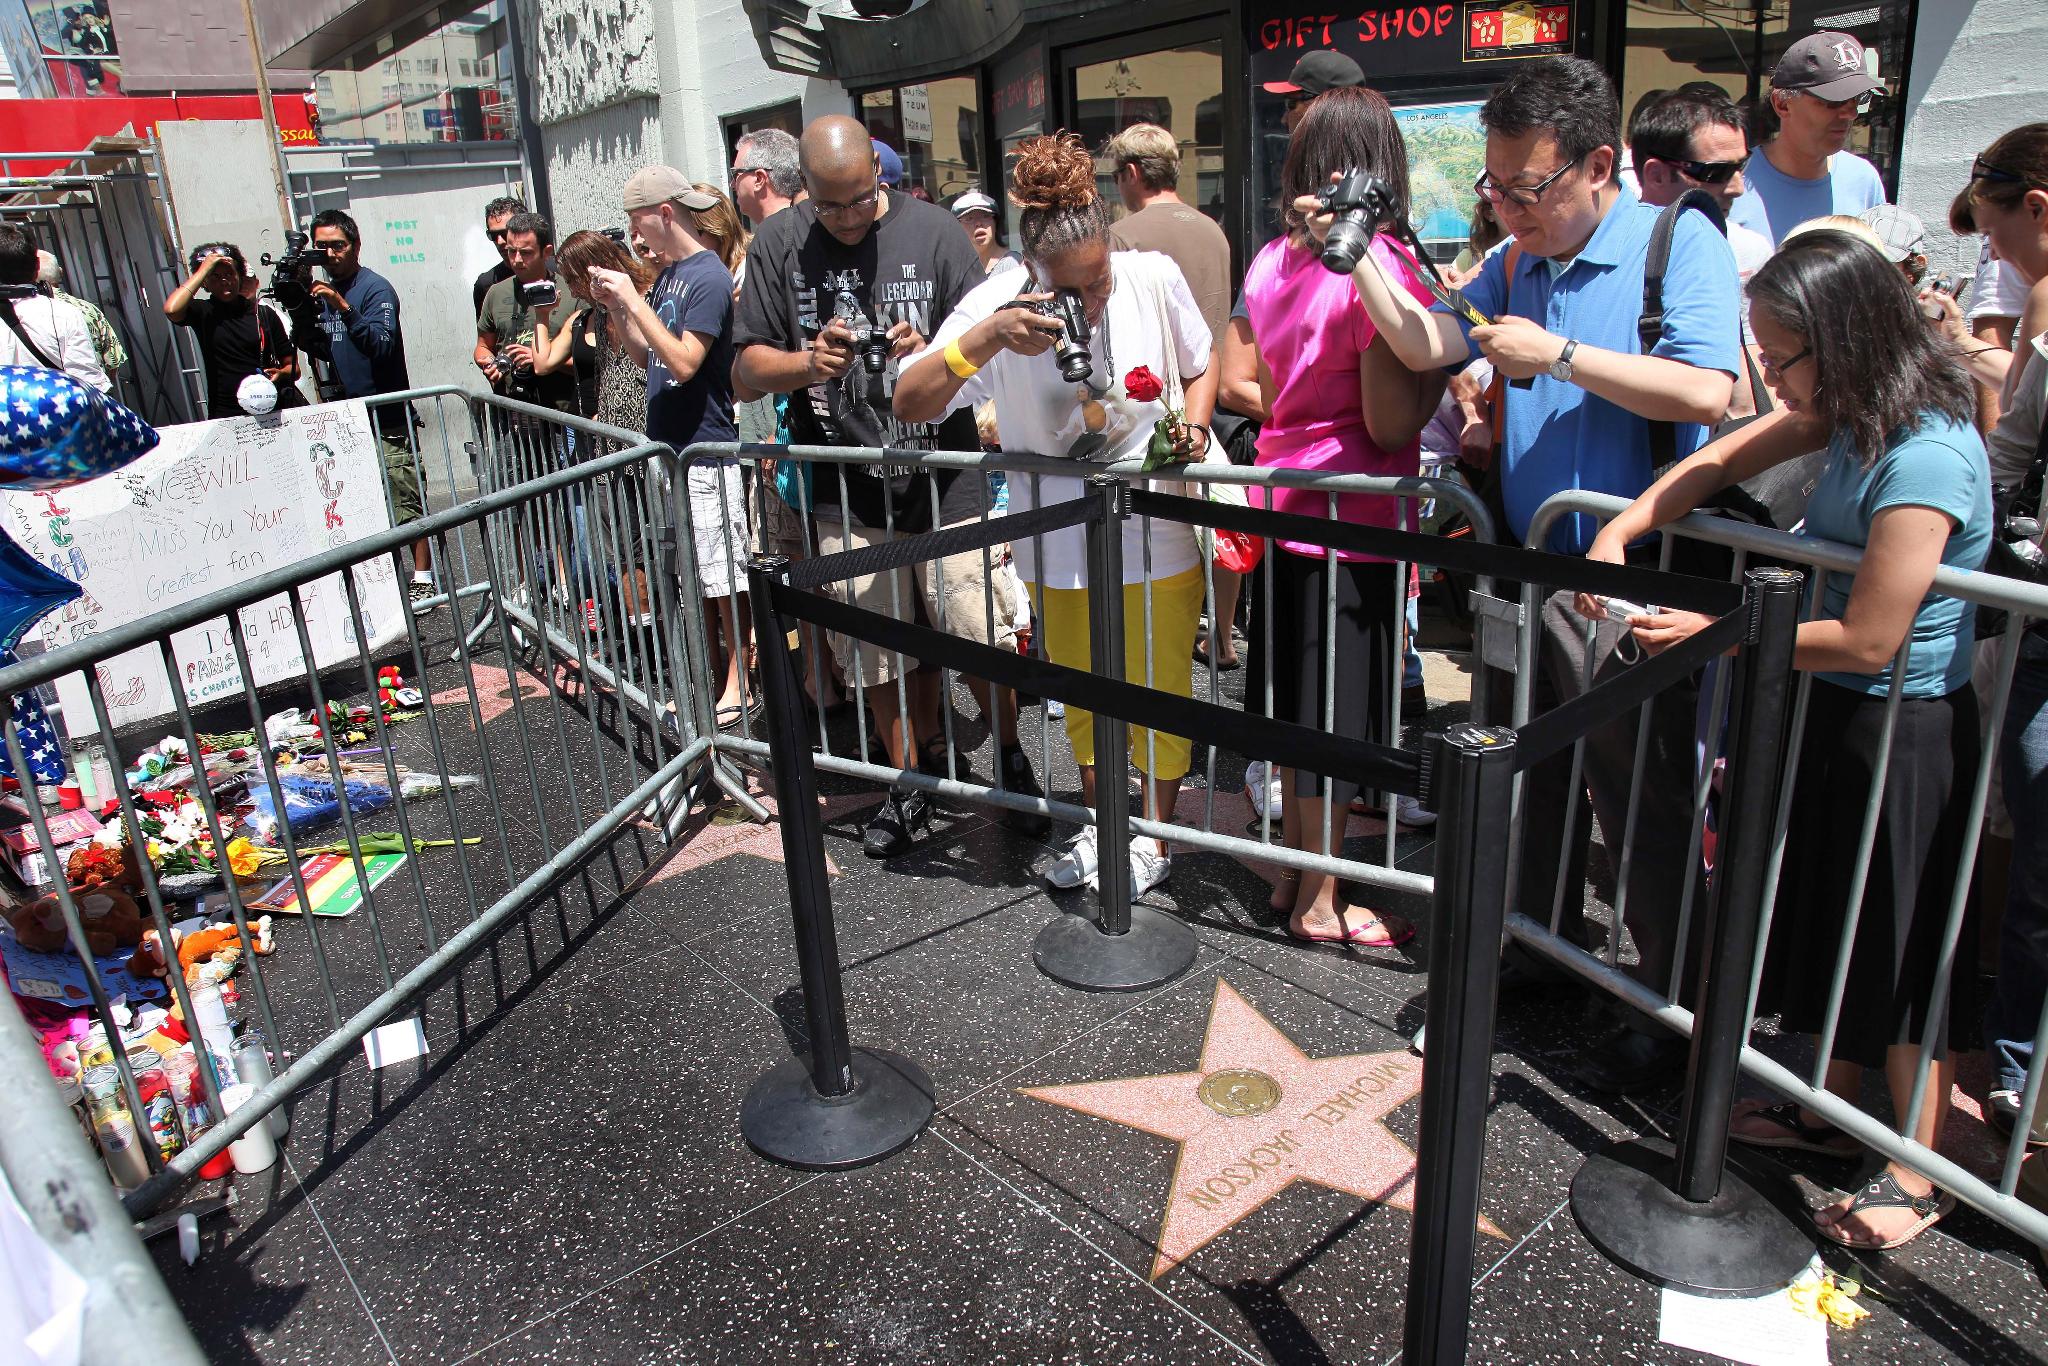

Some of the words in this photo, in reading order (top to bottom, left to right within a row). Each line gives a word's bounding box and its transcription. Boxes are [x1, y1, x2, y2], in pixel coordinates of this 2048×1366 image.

[1261, 16, 1338, 50] GIFT
[1358, 4, 1455, 43] SHOP
[1406, 114, 1419, 122] LOS
[1420, 112, 1449, 121] ANGELES
[280, 128, 316, 142] ssau
[385, 220, 418, 230] POST
[396, 236, 414, 246] NO
[389, 252, 426, 264] BILLS
[902, 264, 916, 279] THE
[881, 280, 934, 302] LEGENDAR
[875, 301, 931, 336] KIN
[889, 464, 910, 478] LIVE
[146, 557, 215, 602] Greatest
[227, 550, 264, 572] fan
[1303, 1062, 1409, 1129] MICHAEL
[1187, 1128, 1303, 1211] JACKSON
